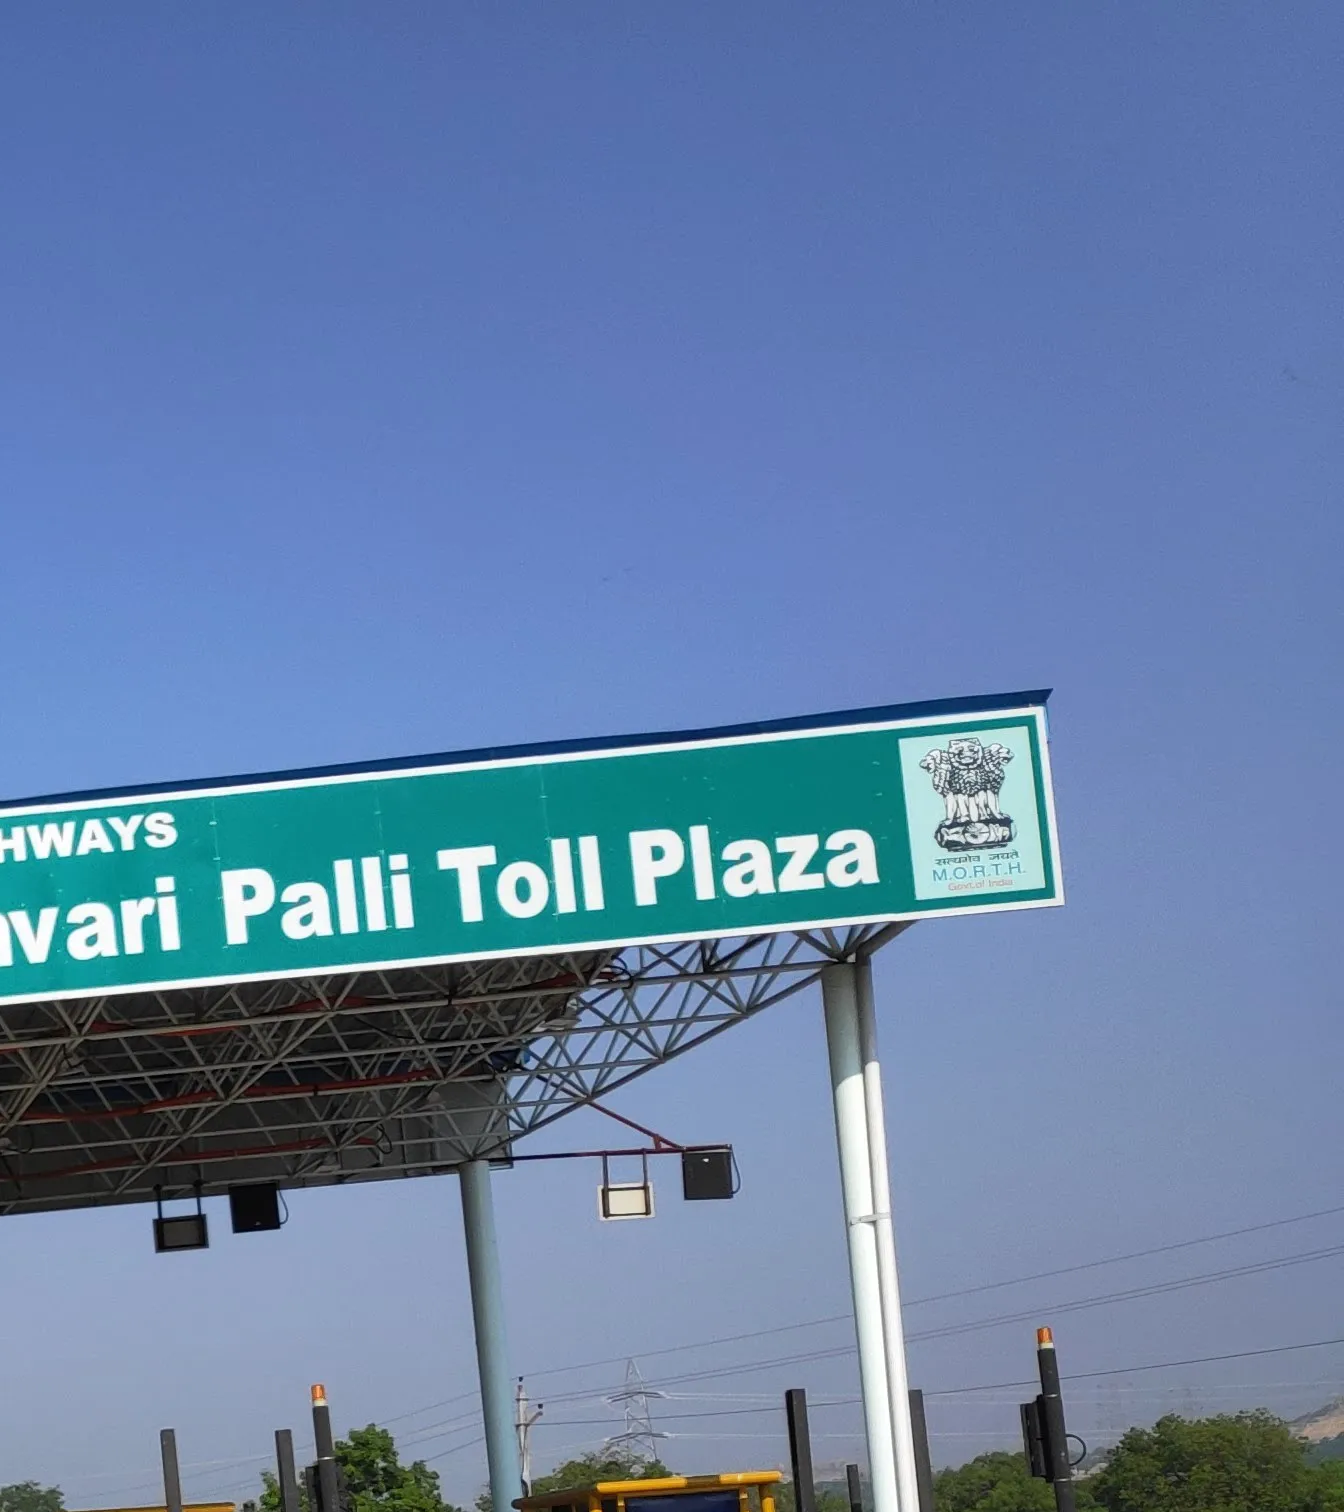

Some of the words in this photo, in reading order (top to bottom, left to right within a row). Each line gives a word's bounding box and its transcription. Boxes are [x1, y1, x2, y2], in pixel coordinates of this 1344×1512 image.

[221, 854, 414, 944] Palli
[437, 836, 604, 922] Toll
[629, 825, 879, 906] Plaza
[932, 862, 1027, 881] M.O.R.T.H.
